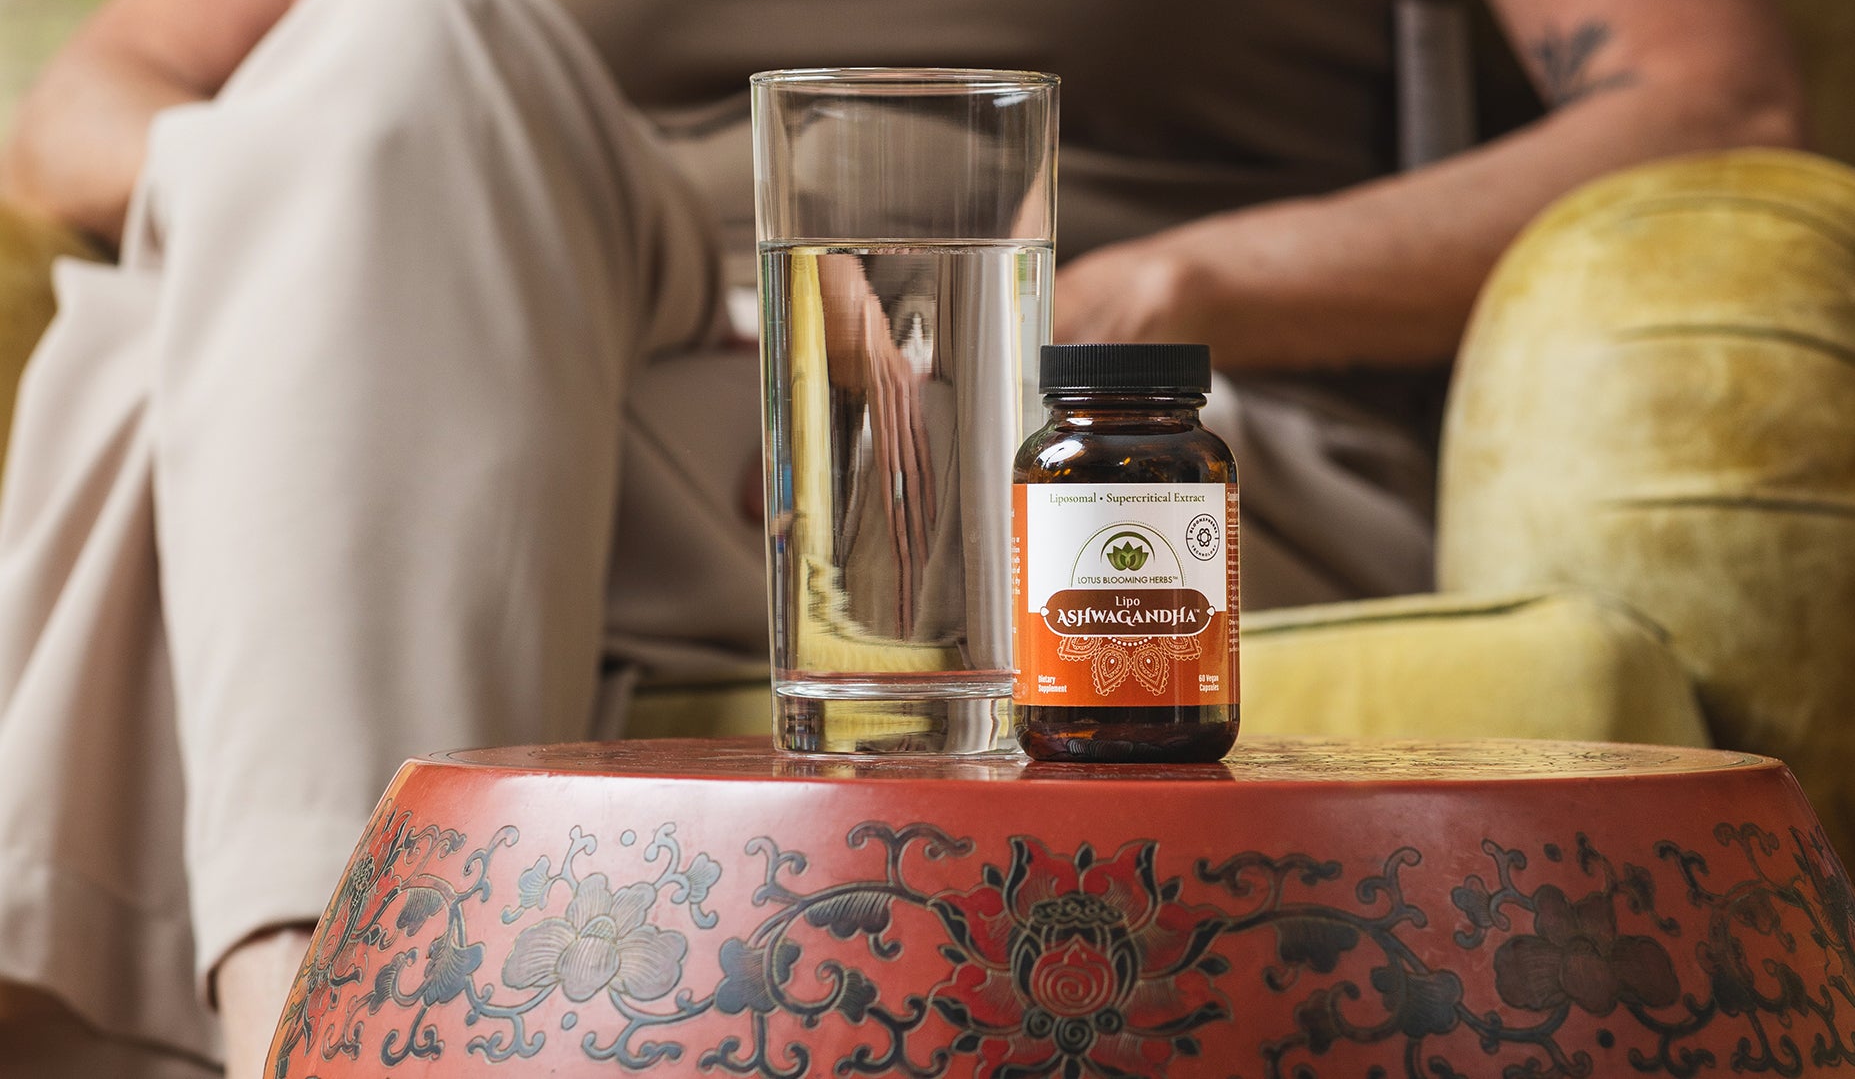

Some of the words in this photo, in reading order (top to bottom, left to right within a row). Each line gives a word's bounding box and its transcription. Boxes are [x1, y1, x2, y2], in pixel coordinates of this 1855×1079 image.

[1049, 492, 1097, 506] Liposomal
[1106, 492, 1171, 506] Supercritical
[1174, 492, 1206, 503] Extract
[1077, 576, 1101, 584] LOTUS
[1103, 576, 1148, 584] BLOOMING
[1115, 595, 1141, 609] Lipo
[1037, 675, 1056, 684] Dietary
[1198, 674, 1205, 683] 60
[1205, 674, 1219, 684] Vegan
[1037, 684, 1067, 694] Supplement
[1199, 683, 1220, 693] Capsules
